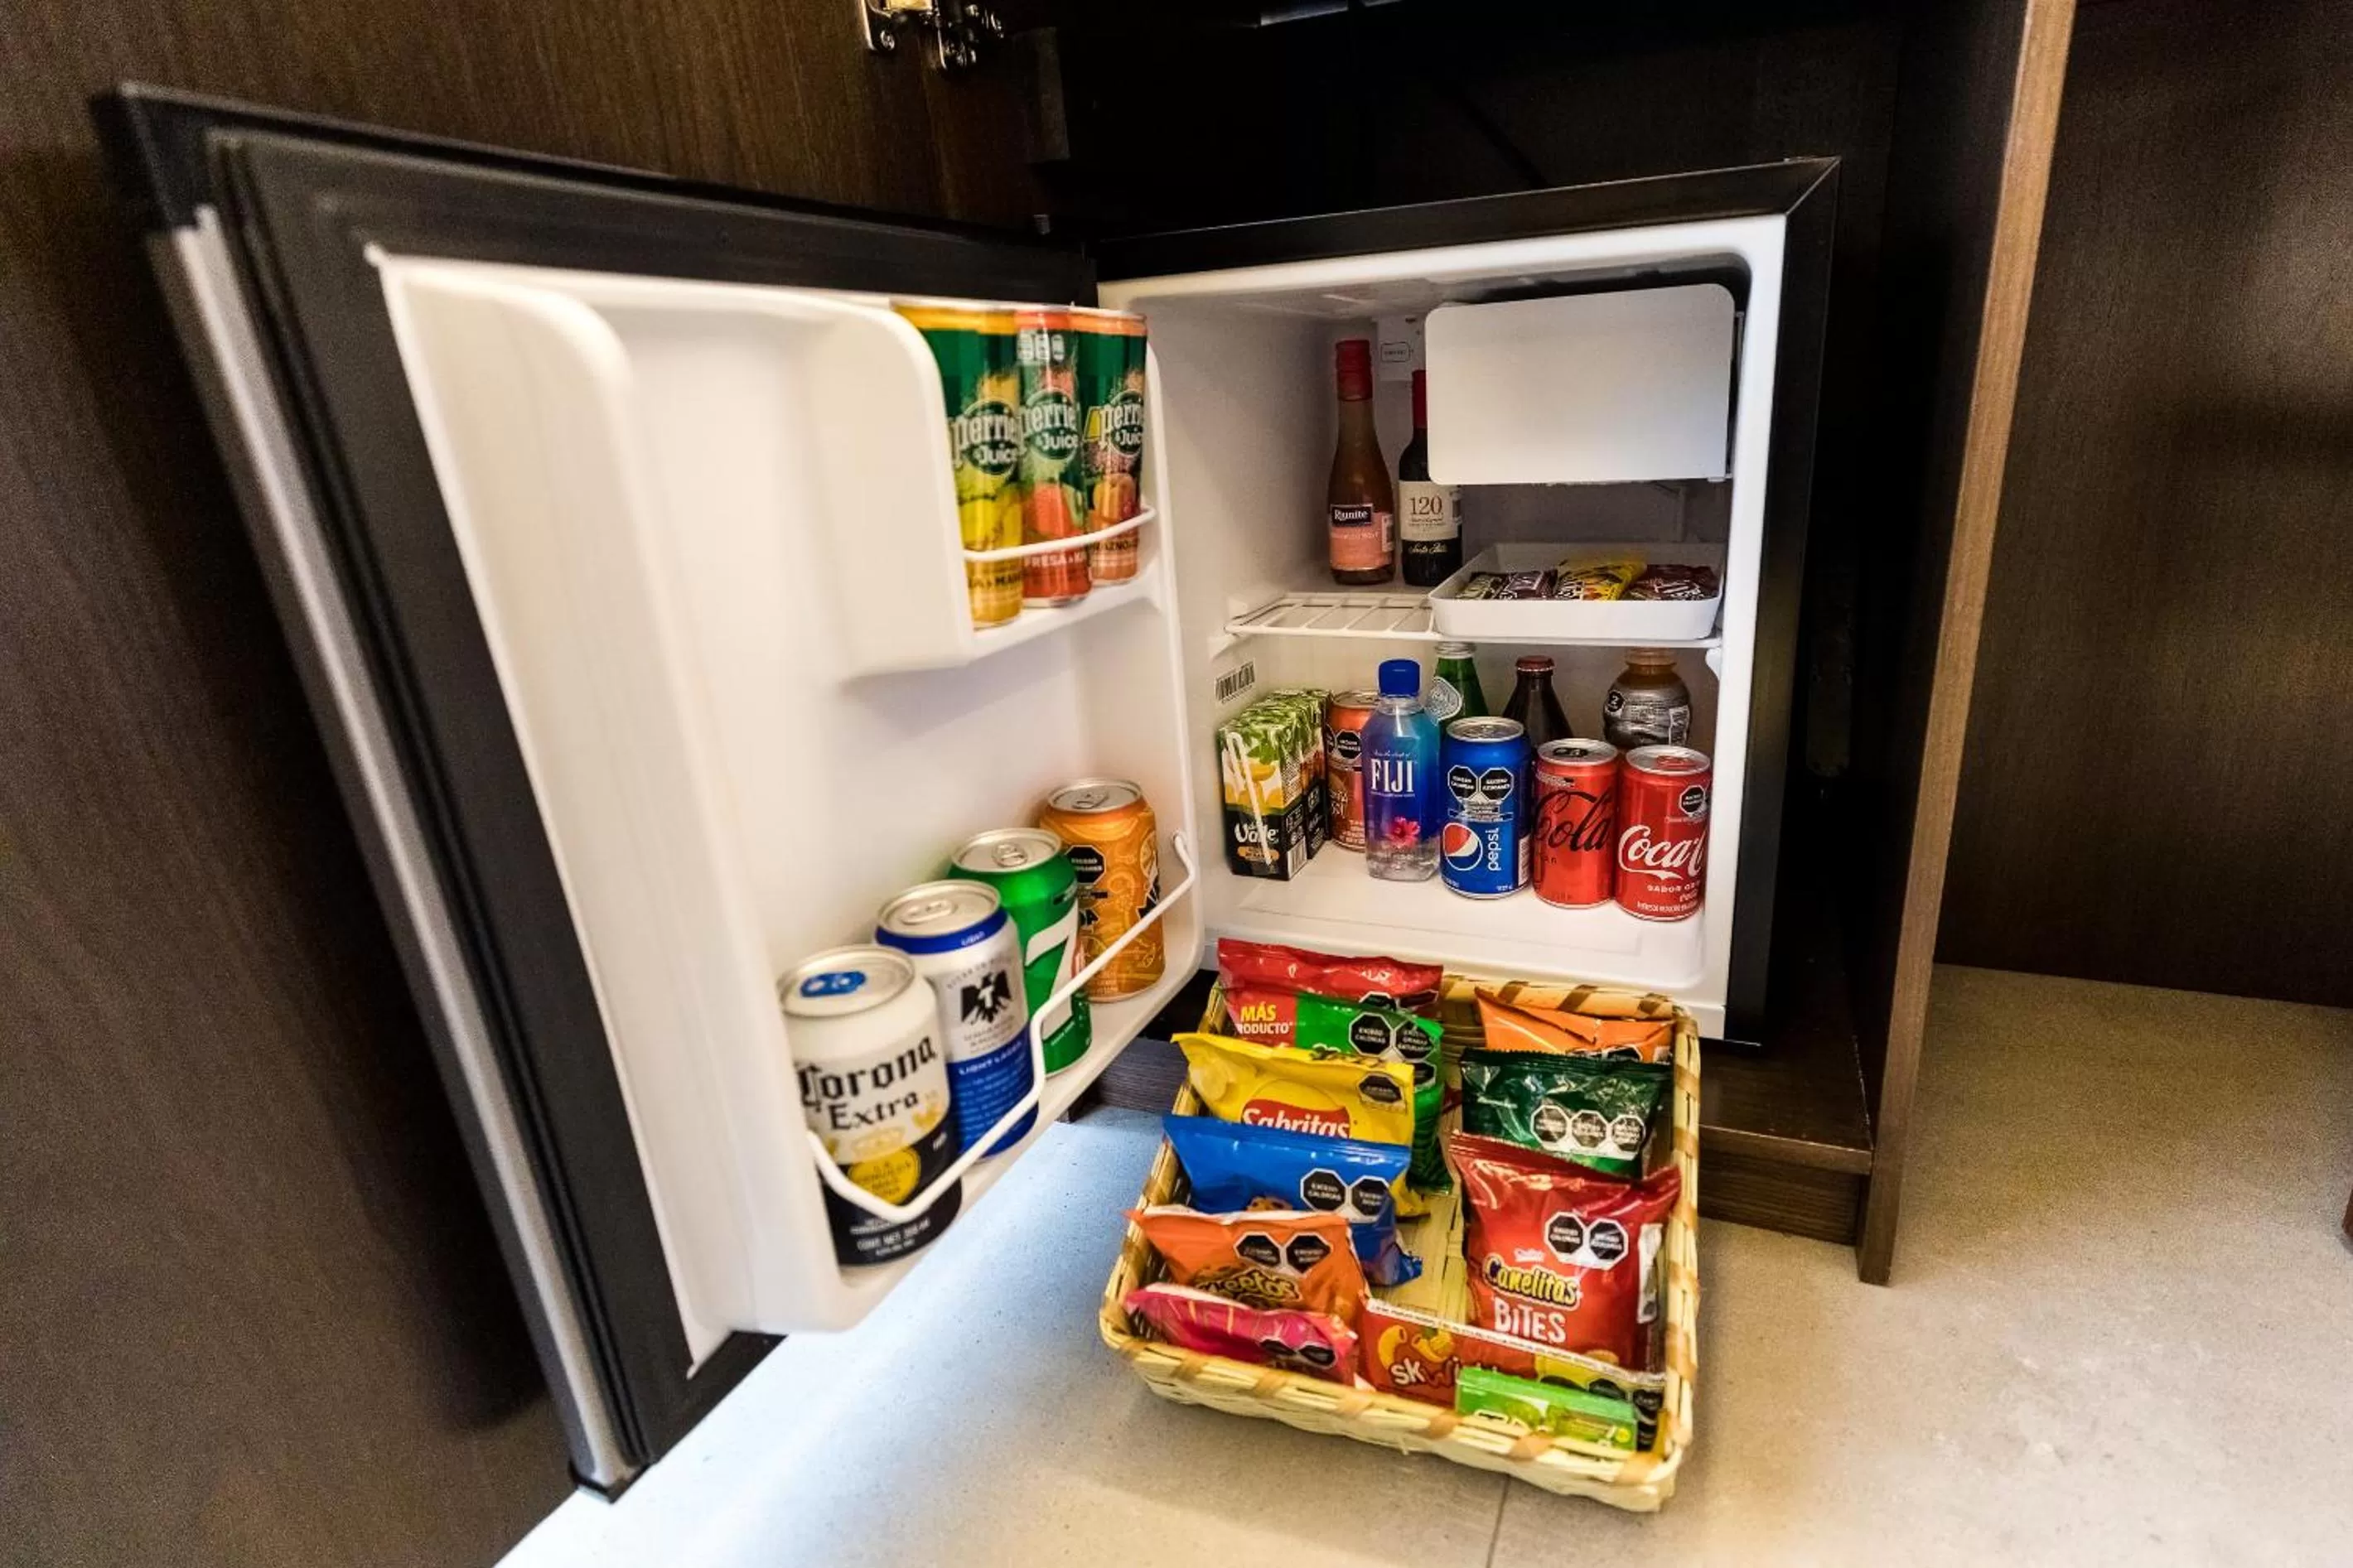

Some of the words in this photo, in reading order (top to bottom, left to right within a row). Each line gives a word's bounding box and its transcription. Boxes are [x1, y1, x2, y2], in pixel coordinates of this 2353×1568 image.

[1119, 428, 1143, 445] Juic
[1409, 496, 1442, 515] 120
[1370, 758, 1414, 793] FIJI
[1234, 822, 1277, 844] Vae
[1486, 827, 1502, 871] pepsi
[1240, 1001, 1277, 1021] MÁS
[797, 1035, 938, 1112] Corona
[829, 1090, 920, 1131] Extra
[1243, 1107, 1350, 1139] Sabritas
[1198, 1271, 1301, 1301] eetos
[1486, 1257, 1578, 1306] Canelitas
